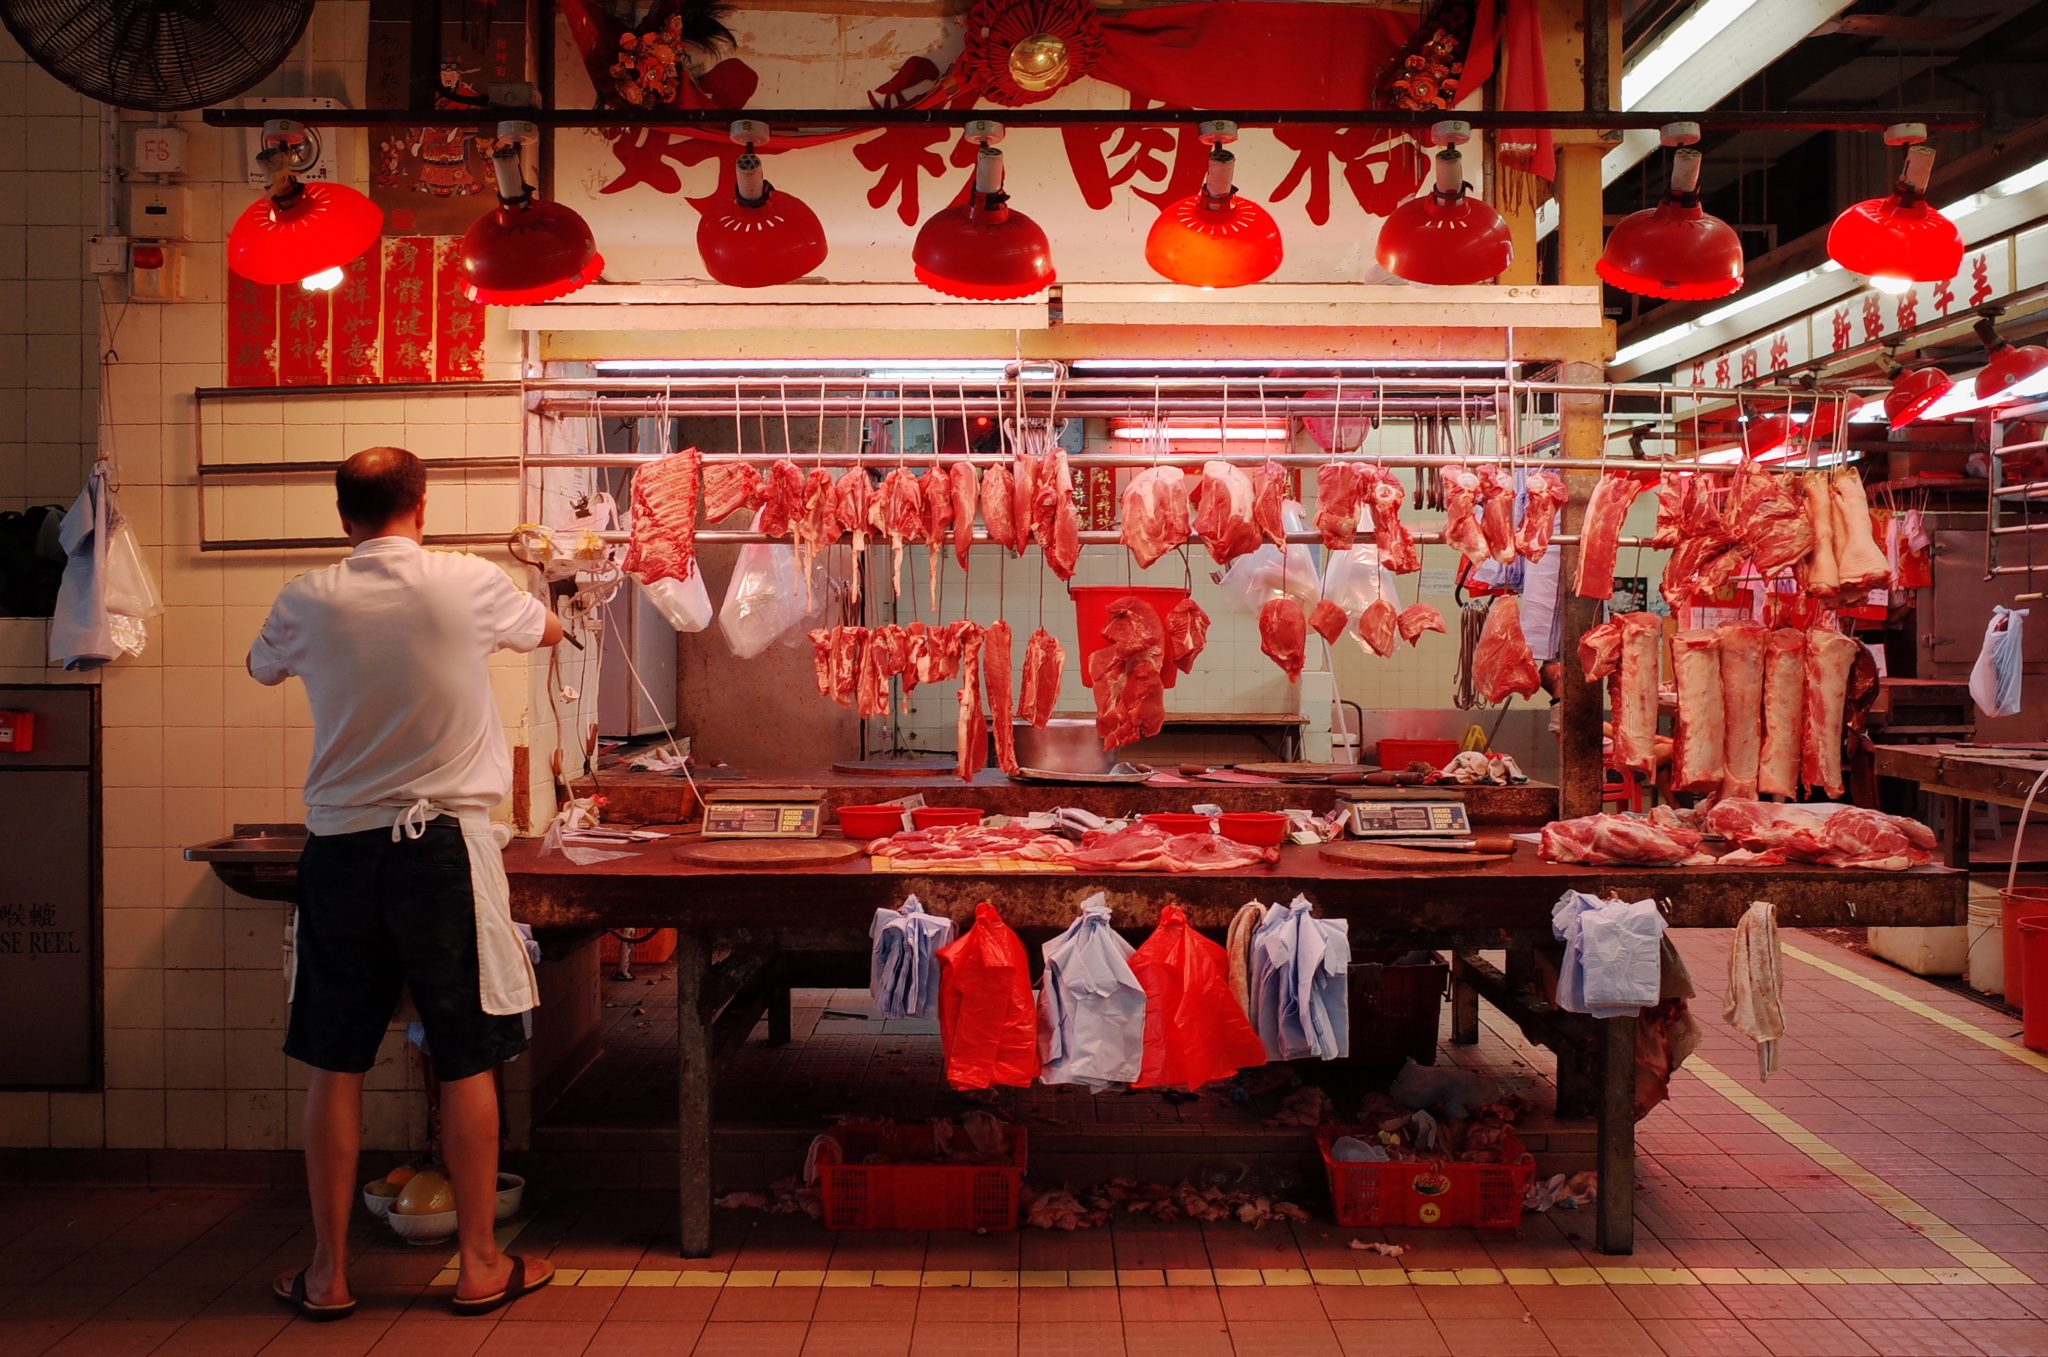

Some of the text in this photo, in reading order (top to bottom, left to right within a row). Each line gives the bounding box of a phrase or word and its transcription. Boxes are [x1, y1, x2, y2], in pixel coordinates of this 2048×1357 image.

[145, 140, 170, 161] FS
[392, 242, 427, 370] 身體健康
[29, 931, 81, 953] REEL
[1424, 1208, 1436, 1216] 4A
